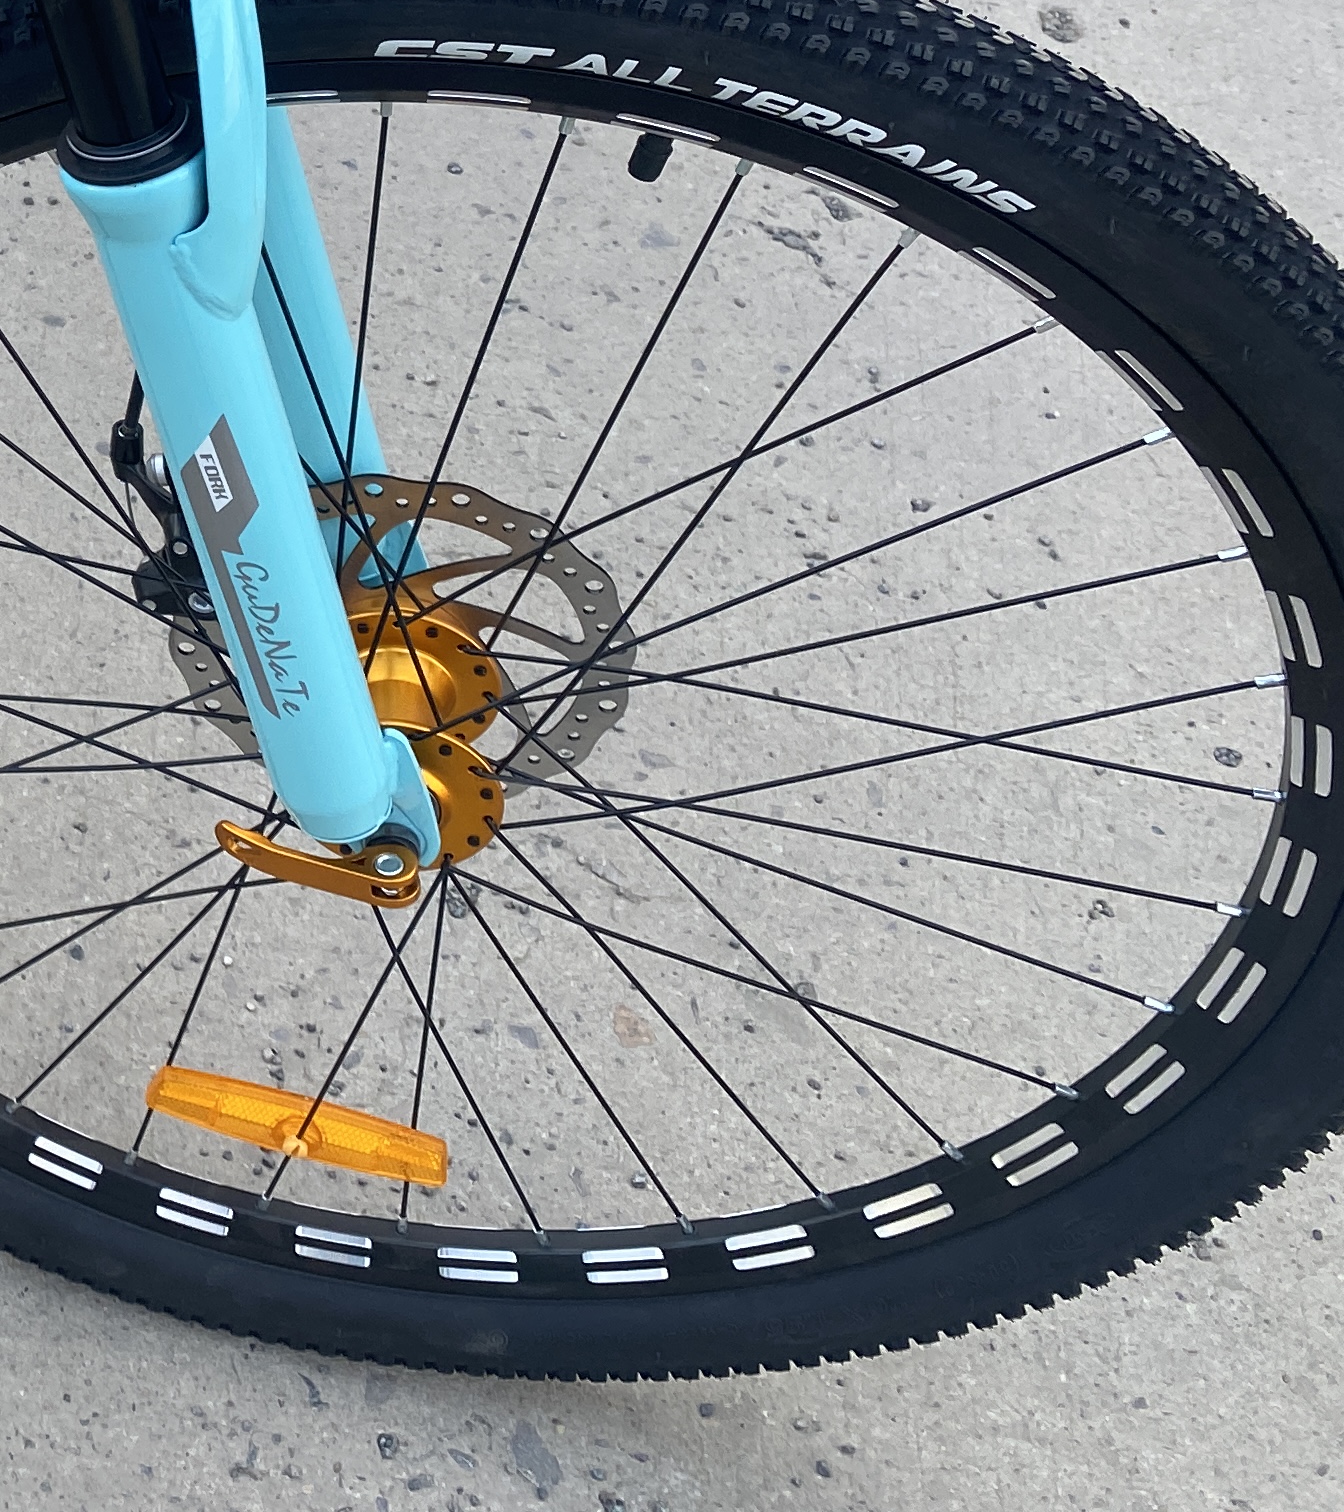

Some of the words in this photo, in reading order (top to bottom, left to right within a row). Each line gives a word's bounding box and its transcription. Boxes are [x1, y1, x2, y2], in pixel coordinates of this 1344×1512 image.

[374, 39, 556, 65] CST
[562, 52, 693, 92] ALL
[711, 77, 1037, 215] TERRAINS
[199, 452, 229, 501] FORK
[234, 561, 310, 719] GuDeNaTe
